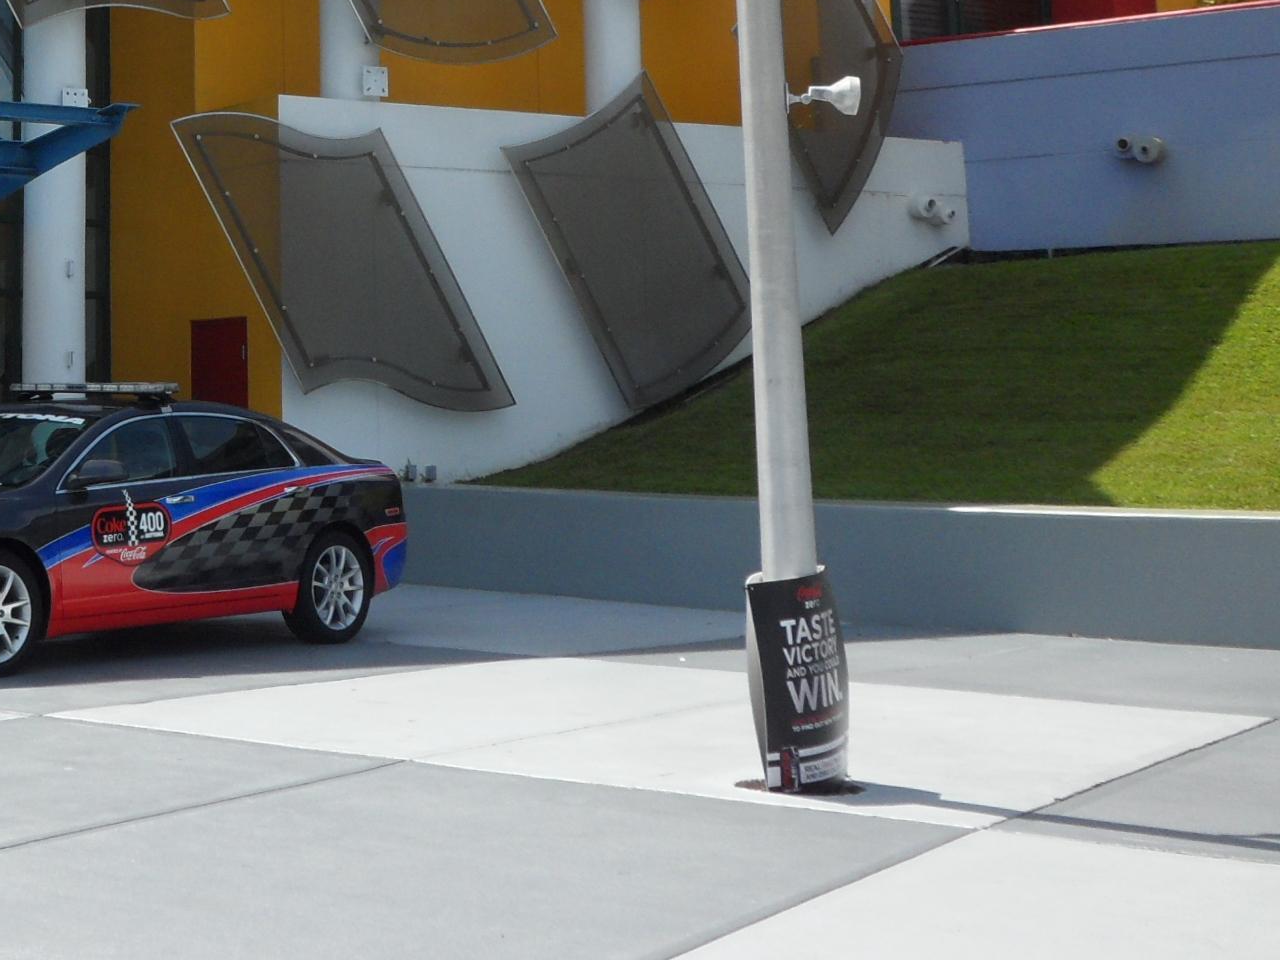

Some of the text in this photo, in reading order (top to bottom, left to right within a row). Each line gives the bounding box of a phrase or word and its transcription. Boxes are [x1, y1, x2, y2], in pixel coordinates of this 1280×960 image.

[139, 511, 165, 533] 400
[779, 608, 836, 646] TASTE
[782, 635, 838, 666] VICTORY
[786, 665, 807, 679] AND
